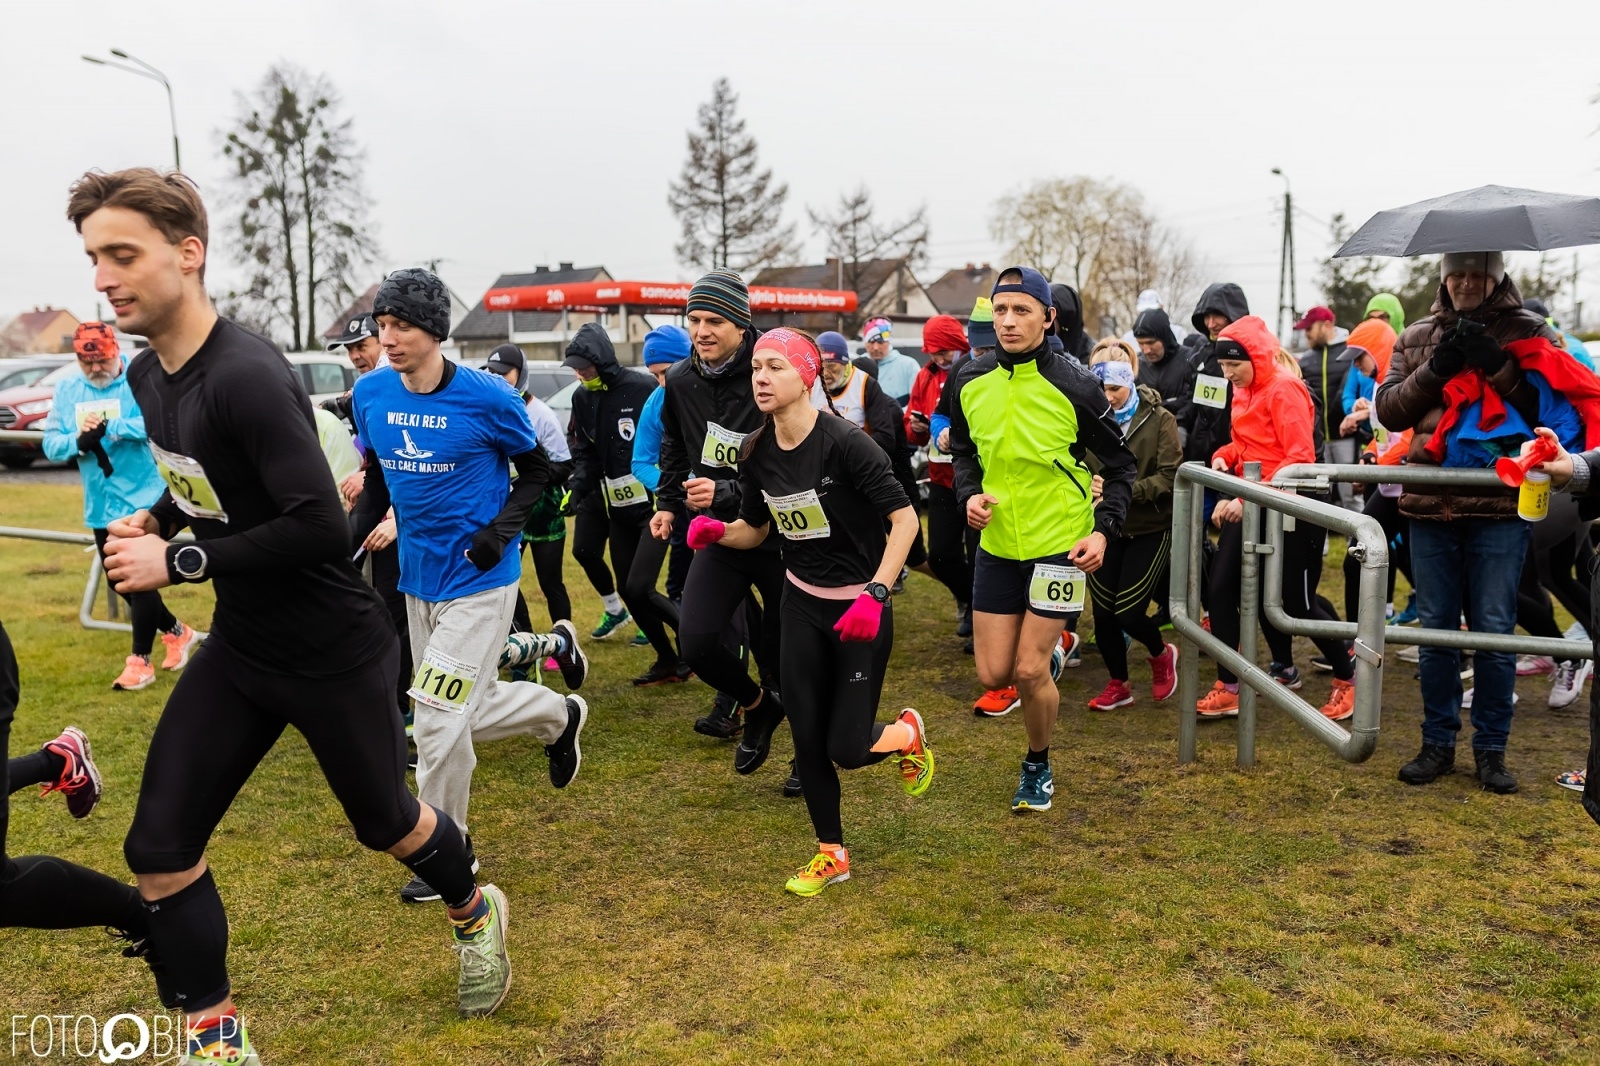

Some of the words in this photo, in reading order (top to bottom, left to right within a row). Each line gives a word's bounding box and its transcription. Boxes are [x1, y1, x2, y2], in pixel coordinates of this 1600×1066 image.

[640, 286, 688, 301] samoob
[1203, 386, 1217, 400] 67
[387, 411, 420, 427] WIELKI
[422, 415, 447, 429] REJS
[715, 443, 739, 464] 60
[398, 460, 417, 472] CAŁE
[419, 462, 456, 473] MAZURY
[169, 470, 202, 506] 62
[614, 486, 634, 501] 68
[777, 510, 808, 531] 80
[1047, 580, 1074, 602] 69
[421, 667, 463, 701] 110
